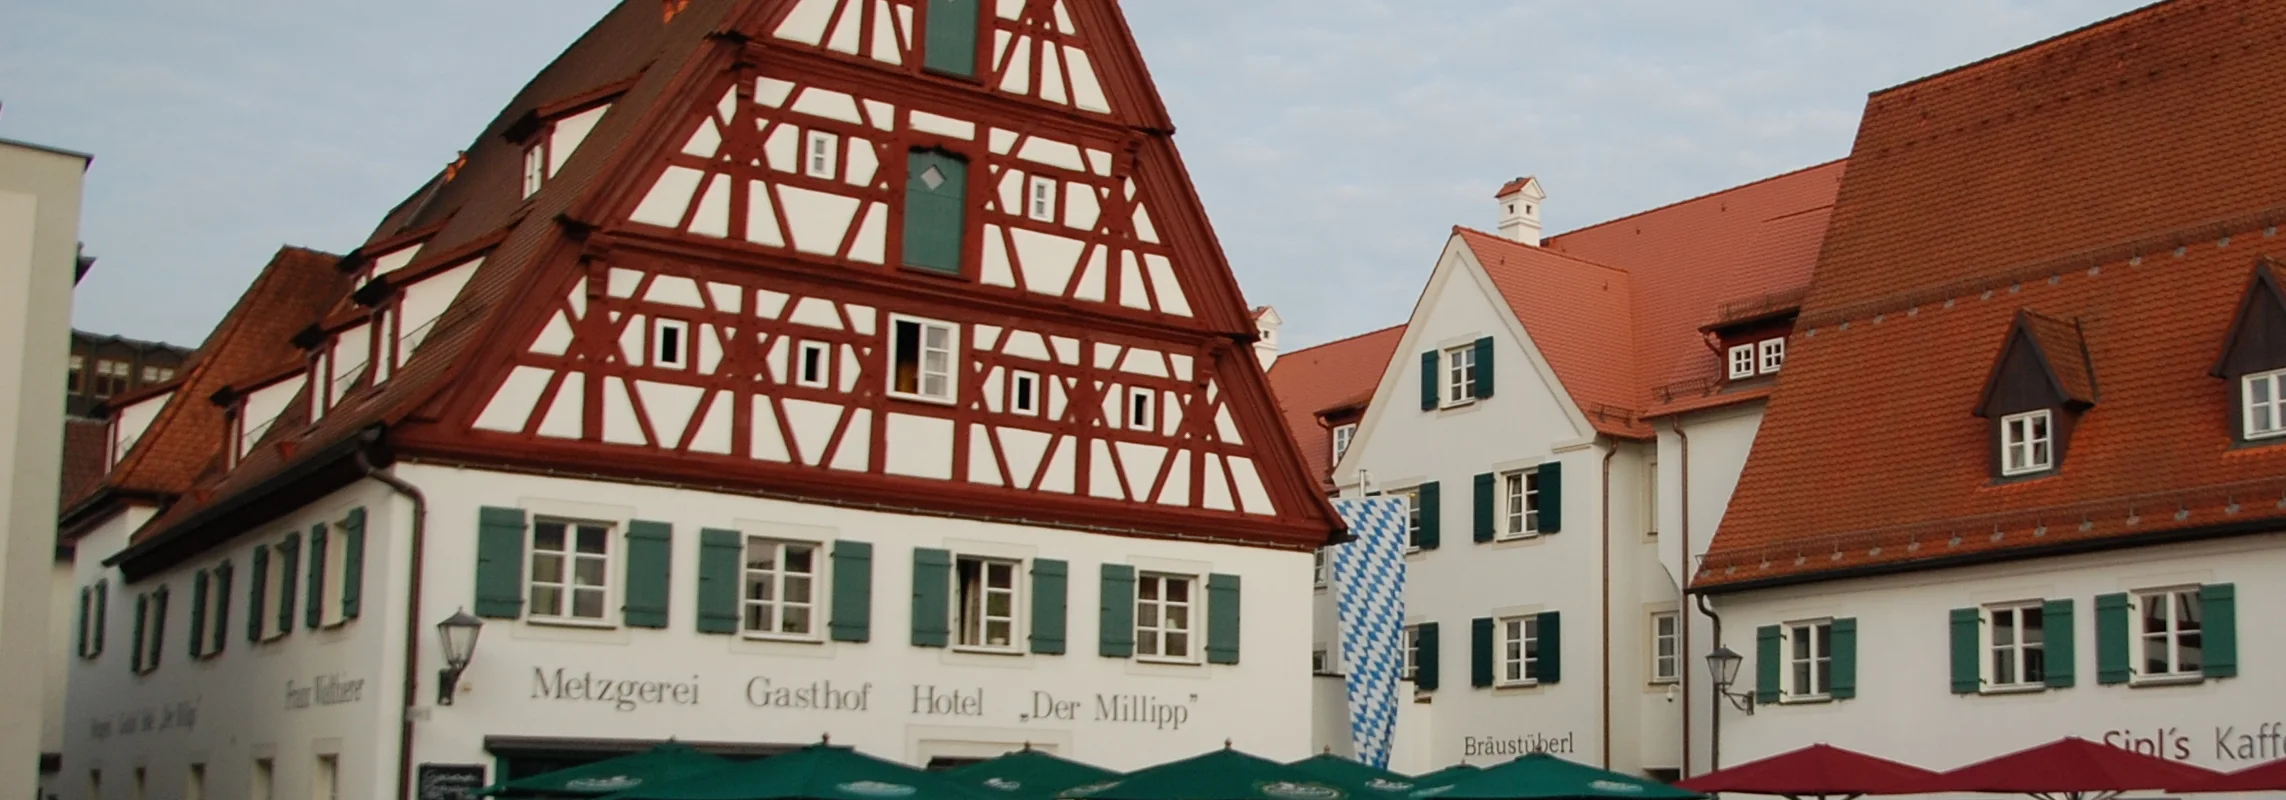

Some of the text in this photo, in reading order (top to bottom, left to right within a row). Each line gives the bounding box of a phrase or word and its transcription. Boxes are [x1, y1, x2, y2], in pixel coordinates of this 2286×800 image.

[530, 666, 700, 712] Metzgerei
[746, 676, 872, 711] Gasthof
[911, 684, 984, 717] Hotel
[1464, 731, 1574, 756] Bräustüberl
[2215, 722, 2286, 760] Kaff
